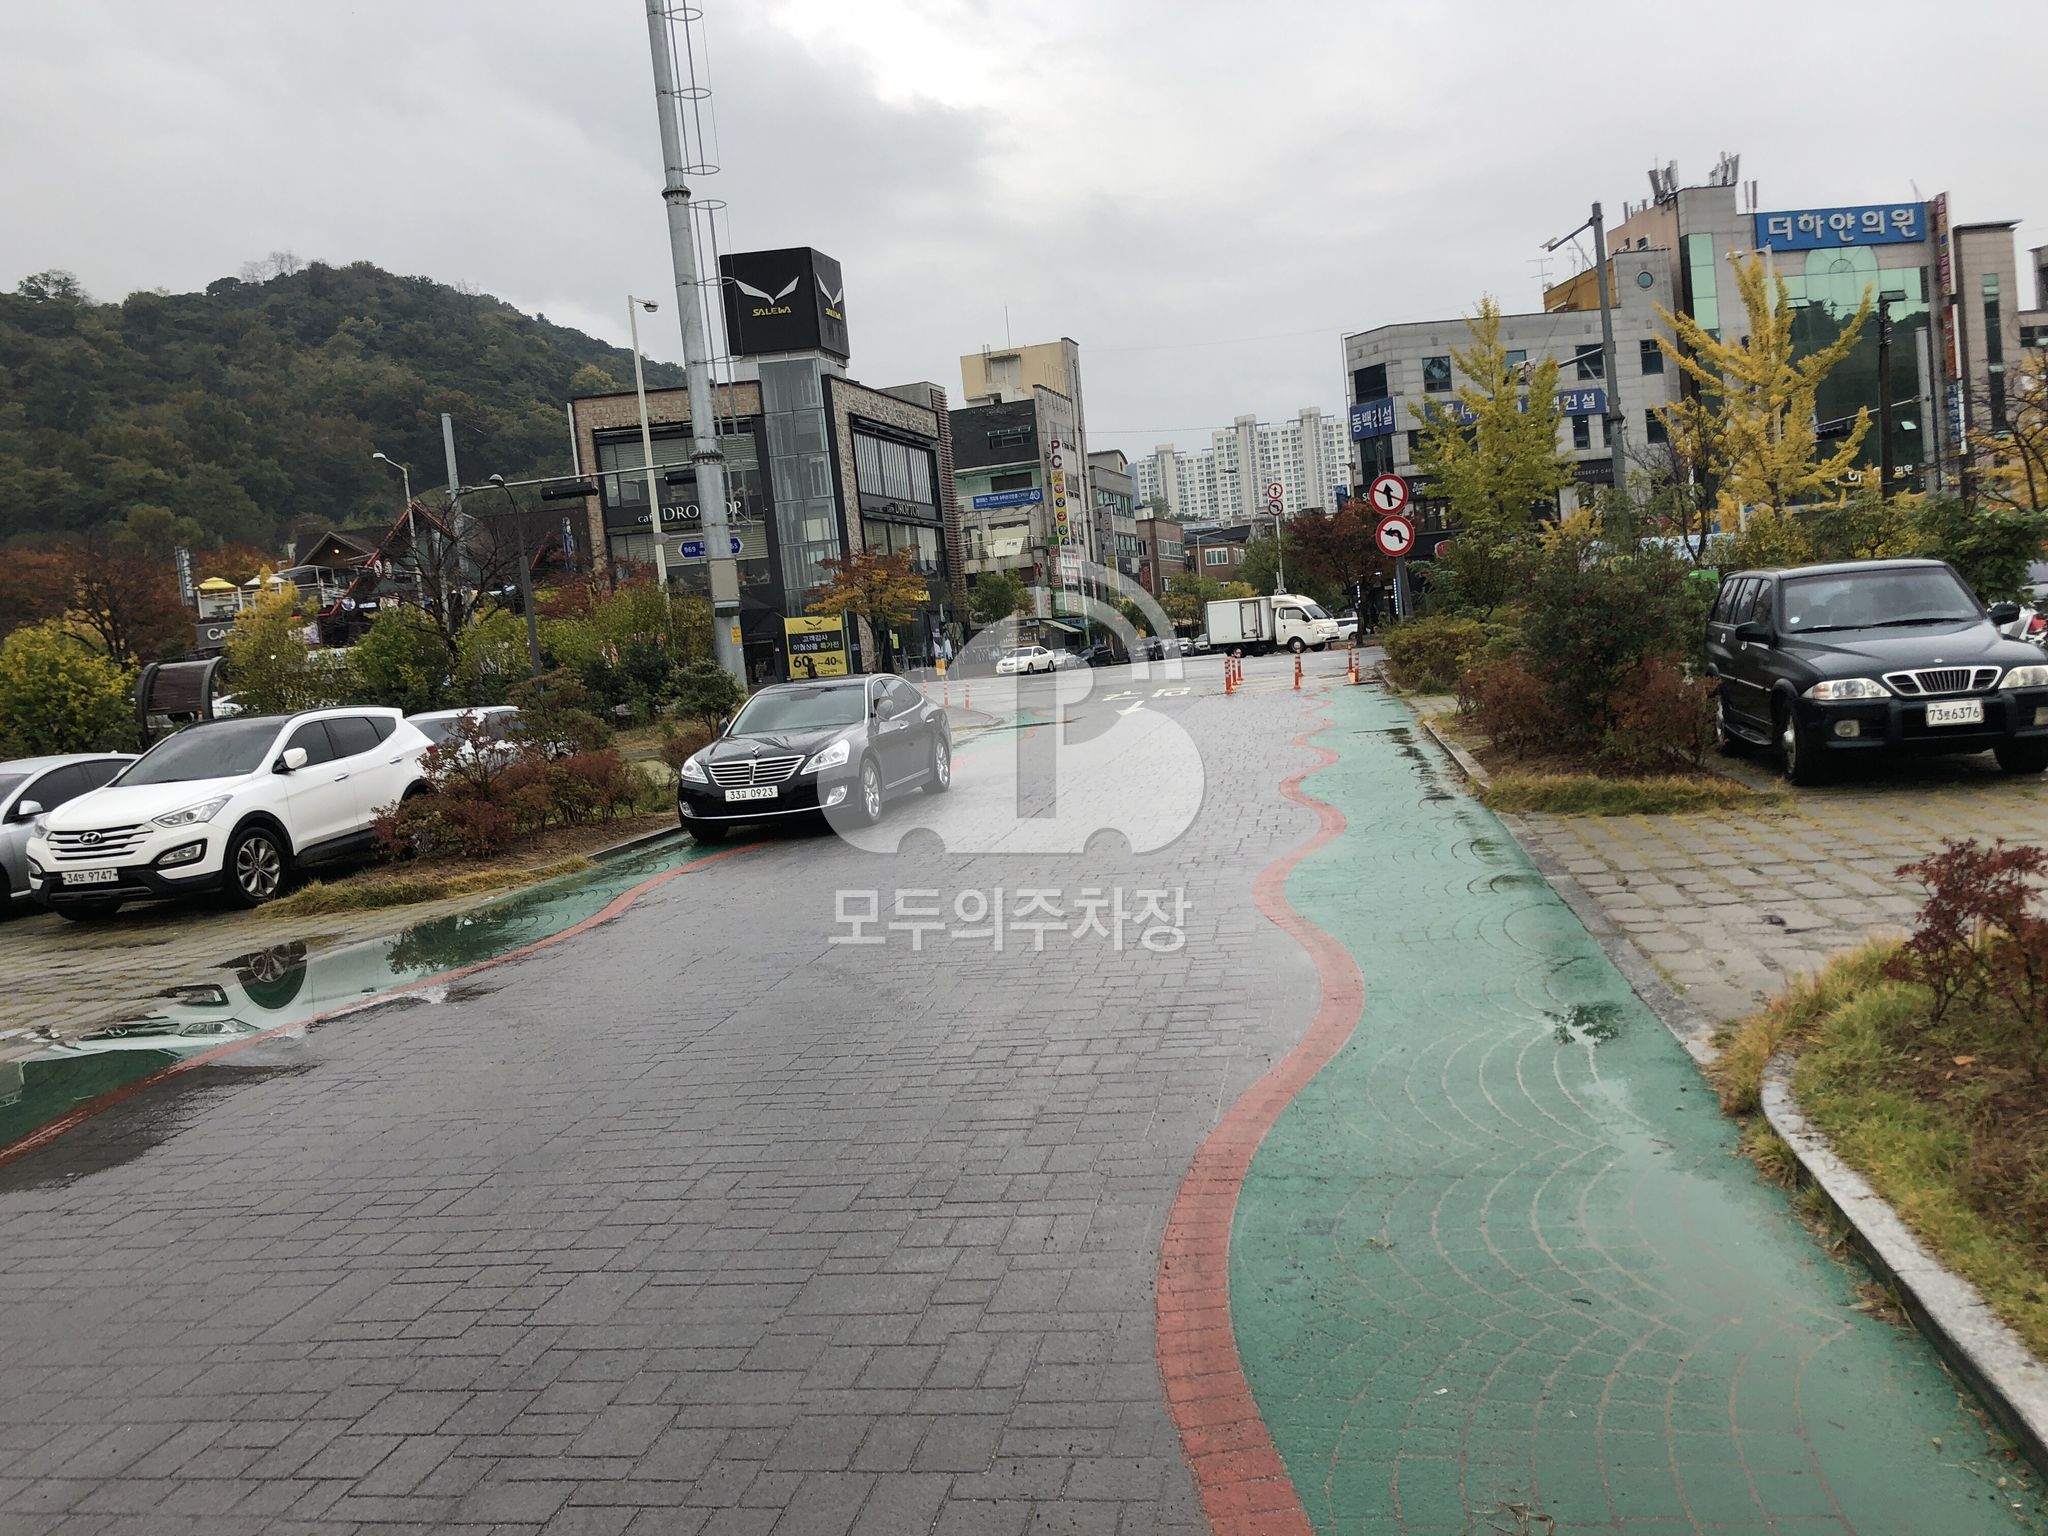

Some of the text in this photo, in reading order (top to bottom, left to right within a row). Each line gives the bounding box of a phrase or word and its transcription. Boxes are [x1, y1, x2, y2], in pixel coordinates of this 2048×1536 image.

[1768, 208, 1917, 242] 더하얀의원
[752, 306, 792, 317] SALEWA
[1550, 392, 1596, 411] 백건설
[1351, 403, 1393, 433] 동백건설
[1051, 440, 1063, 469] PC
[750, 787, 774, 798] 0923
[88, 870, 112, 881] 9747
